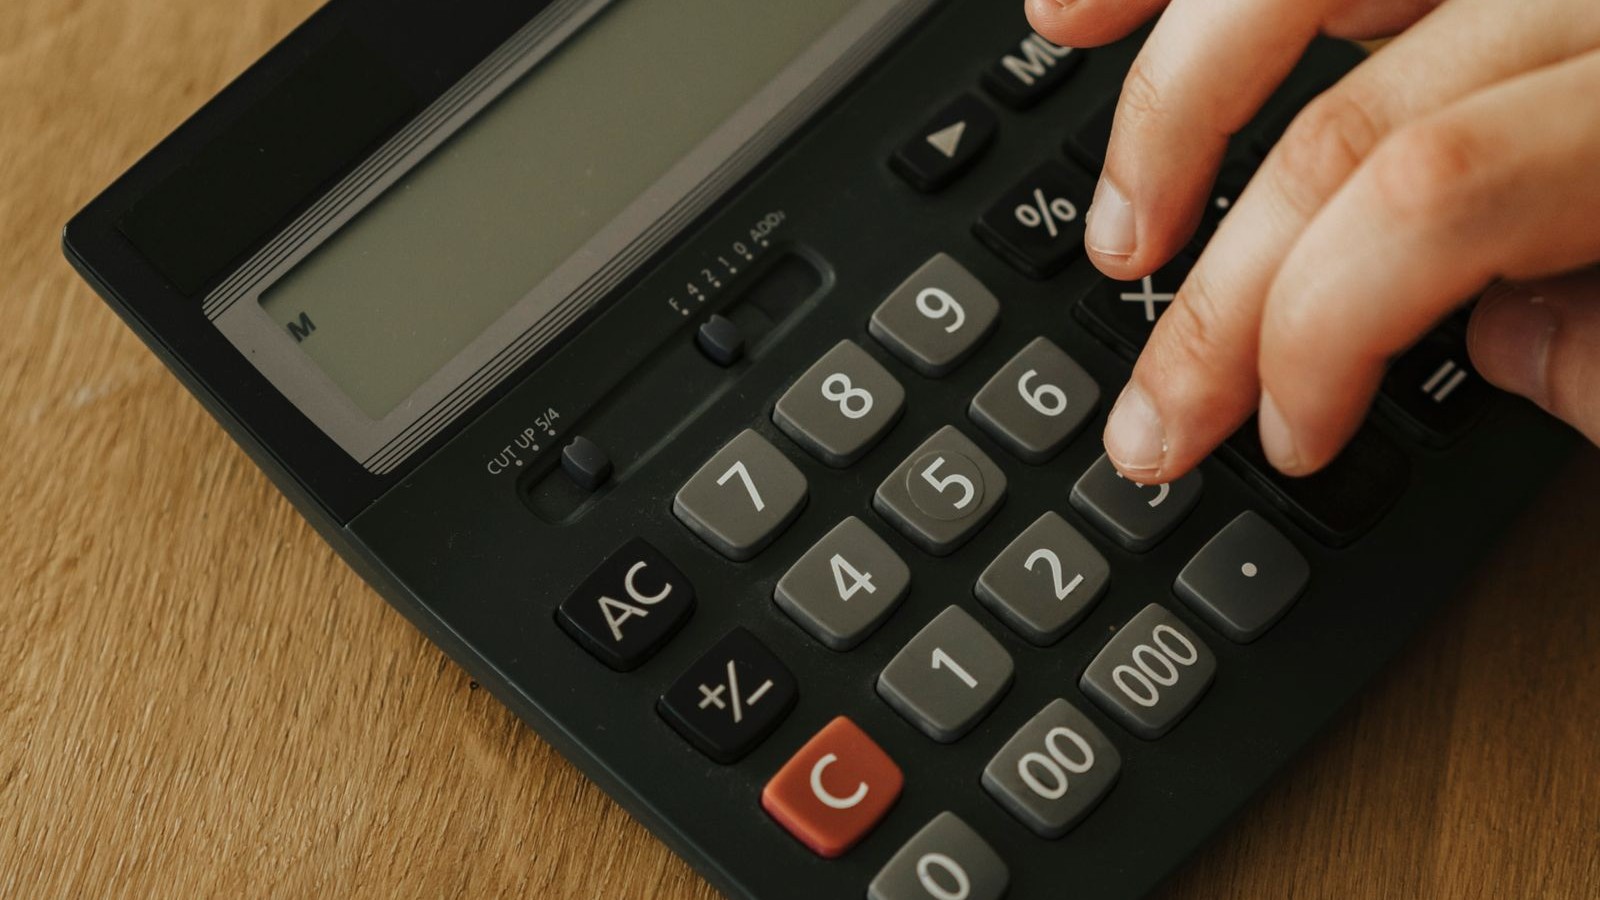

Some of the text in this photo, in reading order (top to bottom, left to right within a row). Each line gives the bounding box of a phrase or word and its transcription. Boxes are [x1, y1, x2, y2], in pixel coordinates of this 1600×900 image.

[702, 269, 715, 282] 2
[287, 311, 316, 343] M
[915, 287, 966, 333] 9
[822, 372, 874, 419] 8
[1017, 369, 1068, 417] 6
[487, 407, 560, 475] CUT UP 5/4
[716, 460, 765, 512] 7
[920, 456, 975, 510] 5
[829, 553, 877, 602] 4
[1023, 548, 1084, 601] 2
[598, 560, 673, 641] AC
[931, 647, 978, 689] 1
[1112, 624, 1198, 707] 000
[810, 753, 869, 809] C
[1017, 726, 1095, 800] 00
[917, 852, 970, 900] 0
